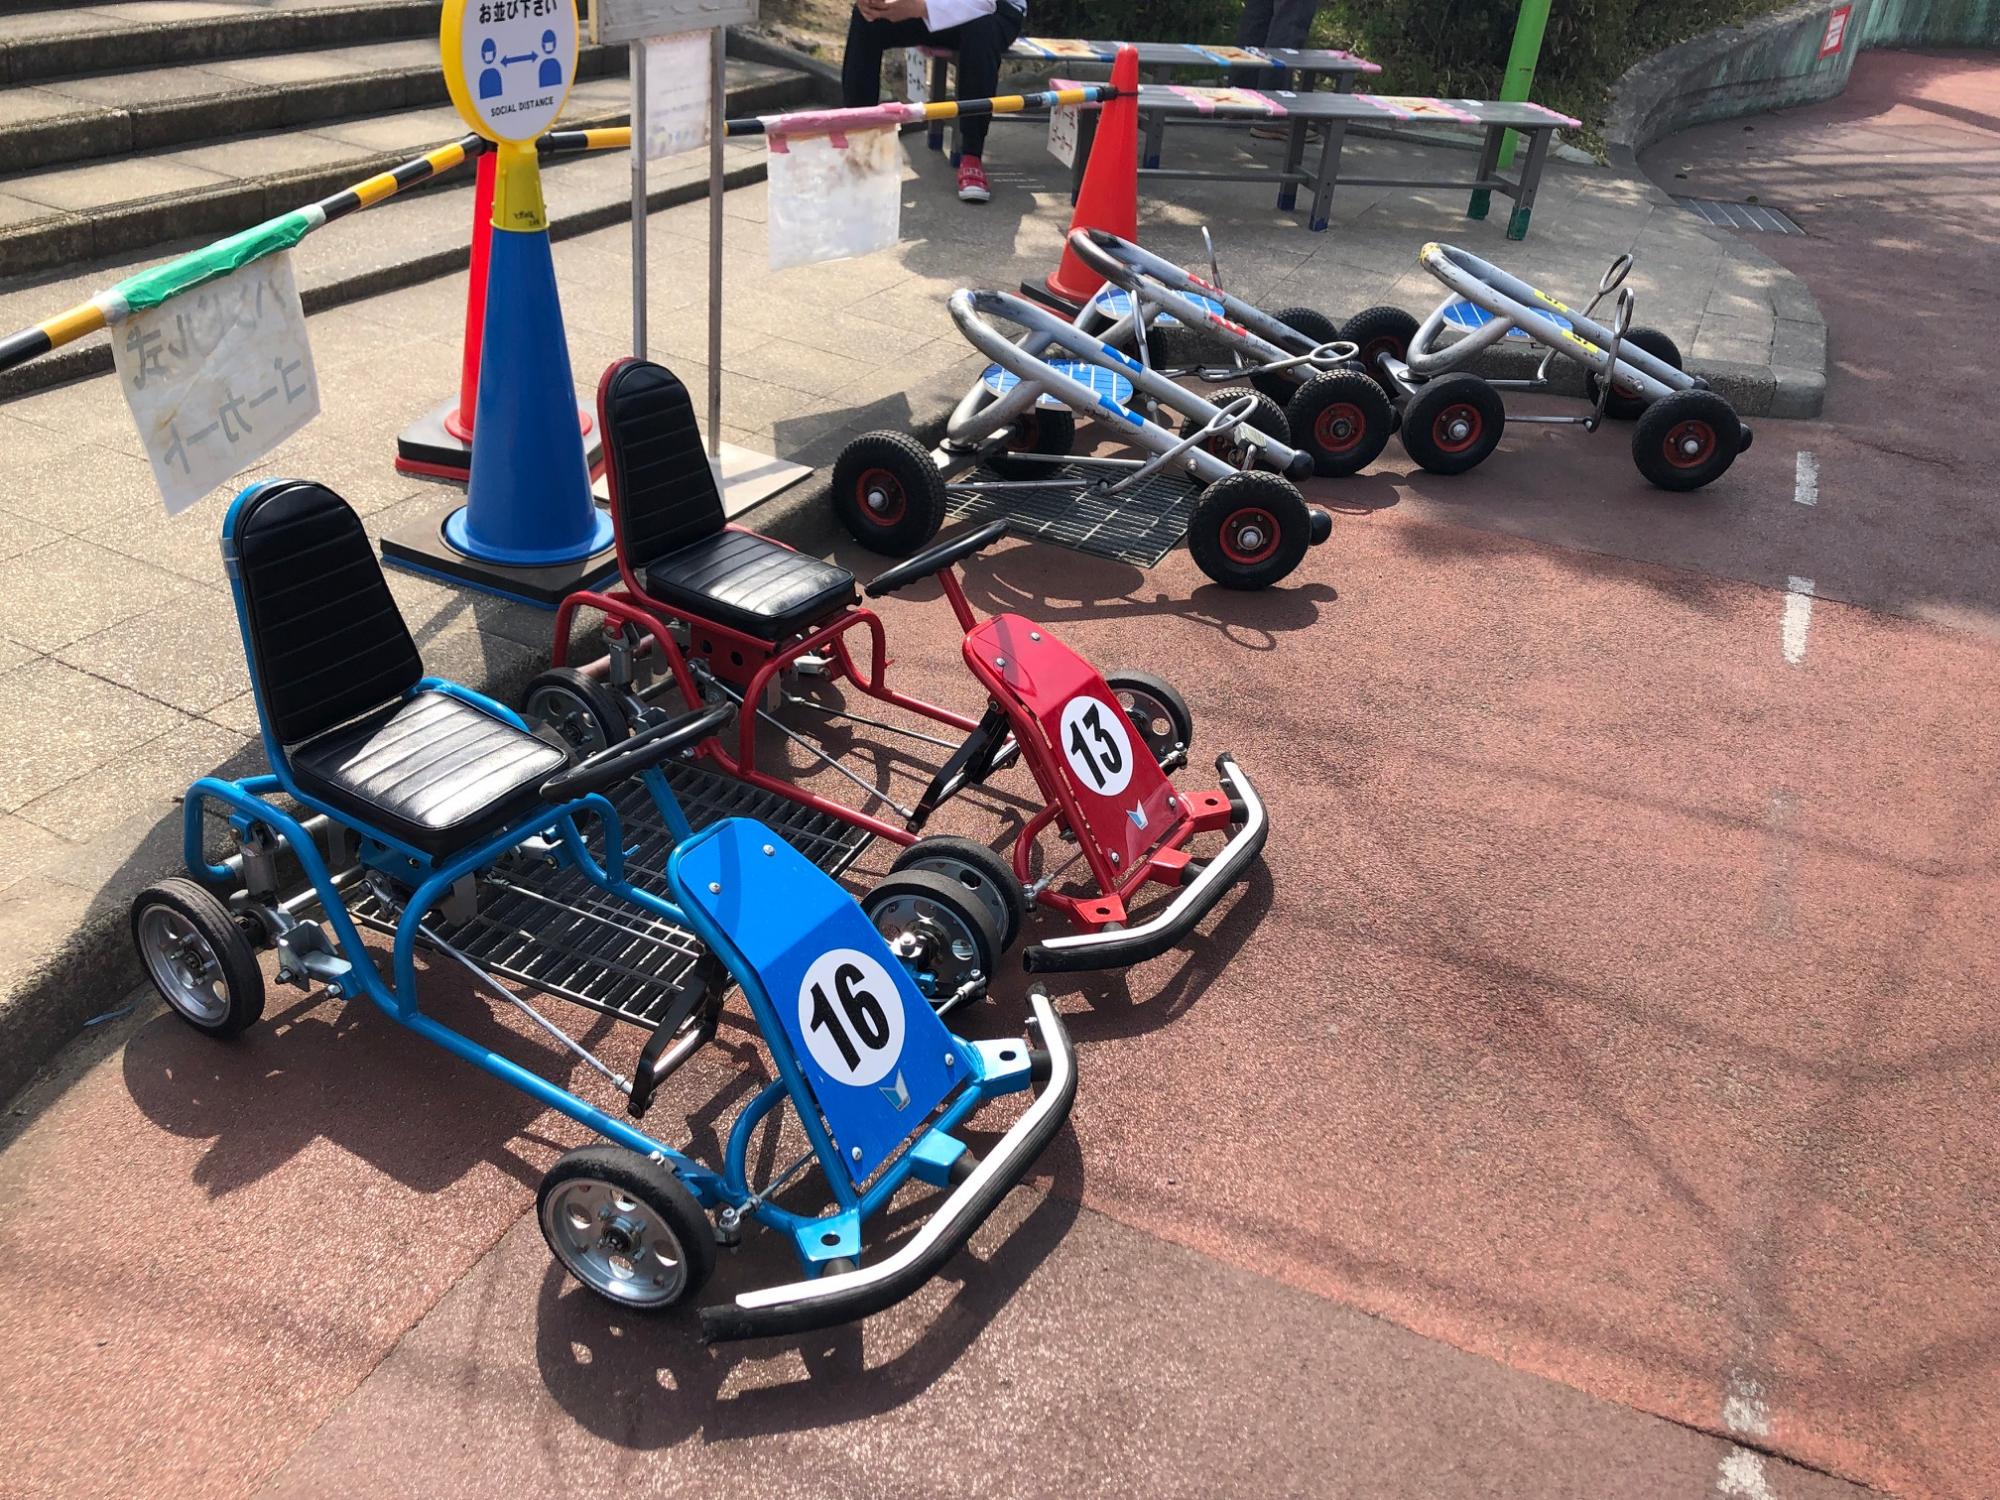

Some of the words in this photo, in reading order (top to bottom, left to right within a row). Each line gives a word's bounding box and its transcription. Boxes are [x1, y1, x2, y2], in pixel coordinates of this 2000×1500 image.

[479, 0, 558, 24] お並び下さい
[490, 103, 517, 117] SOCIAL
[518, 96, 553, 111] DISTANCE
[1070, 702, 1123, 790] 13
[810, 963, 890, 1073] 16
